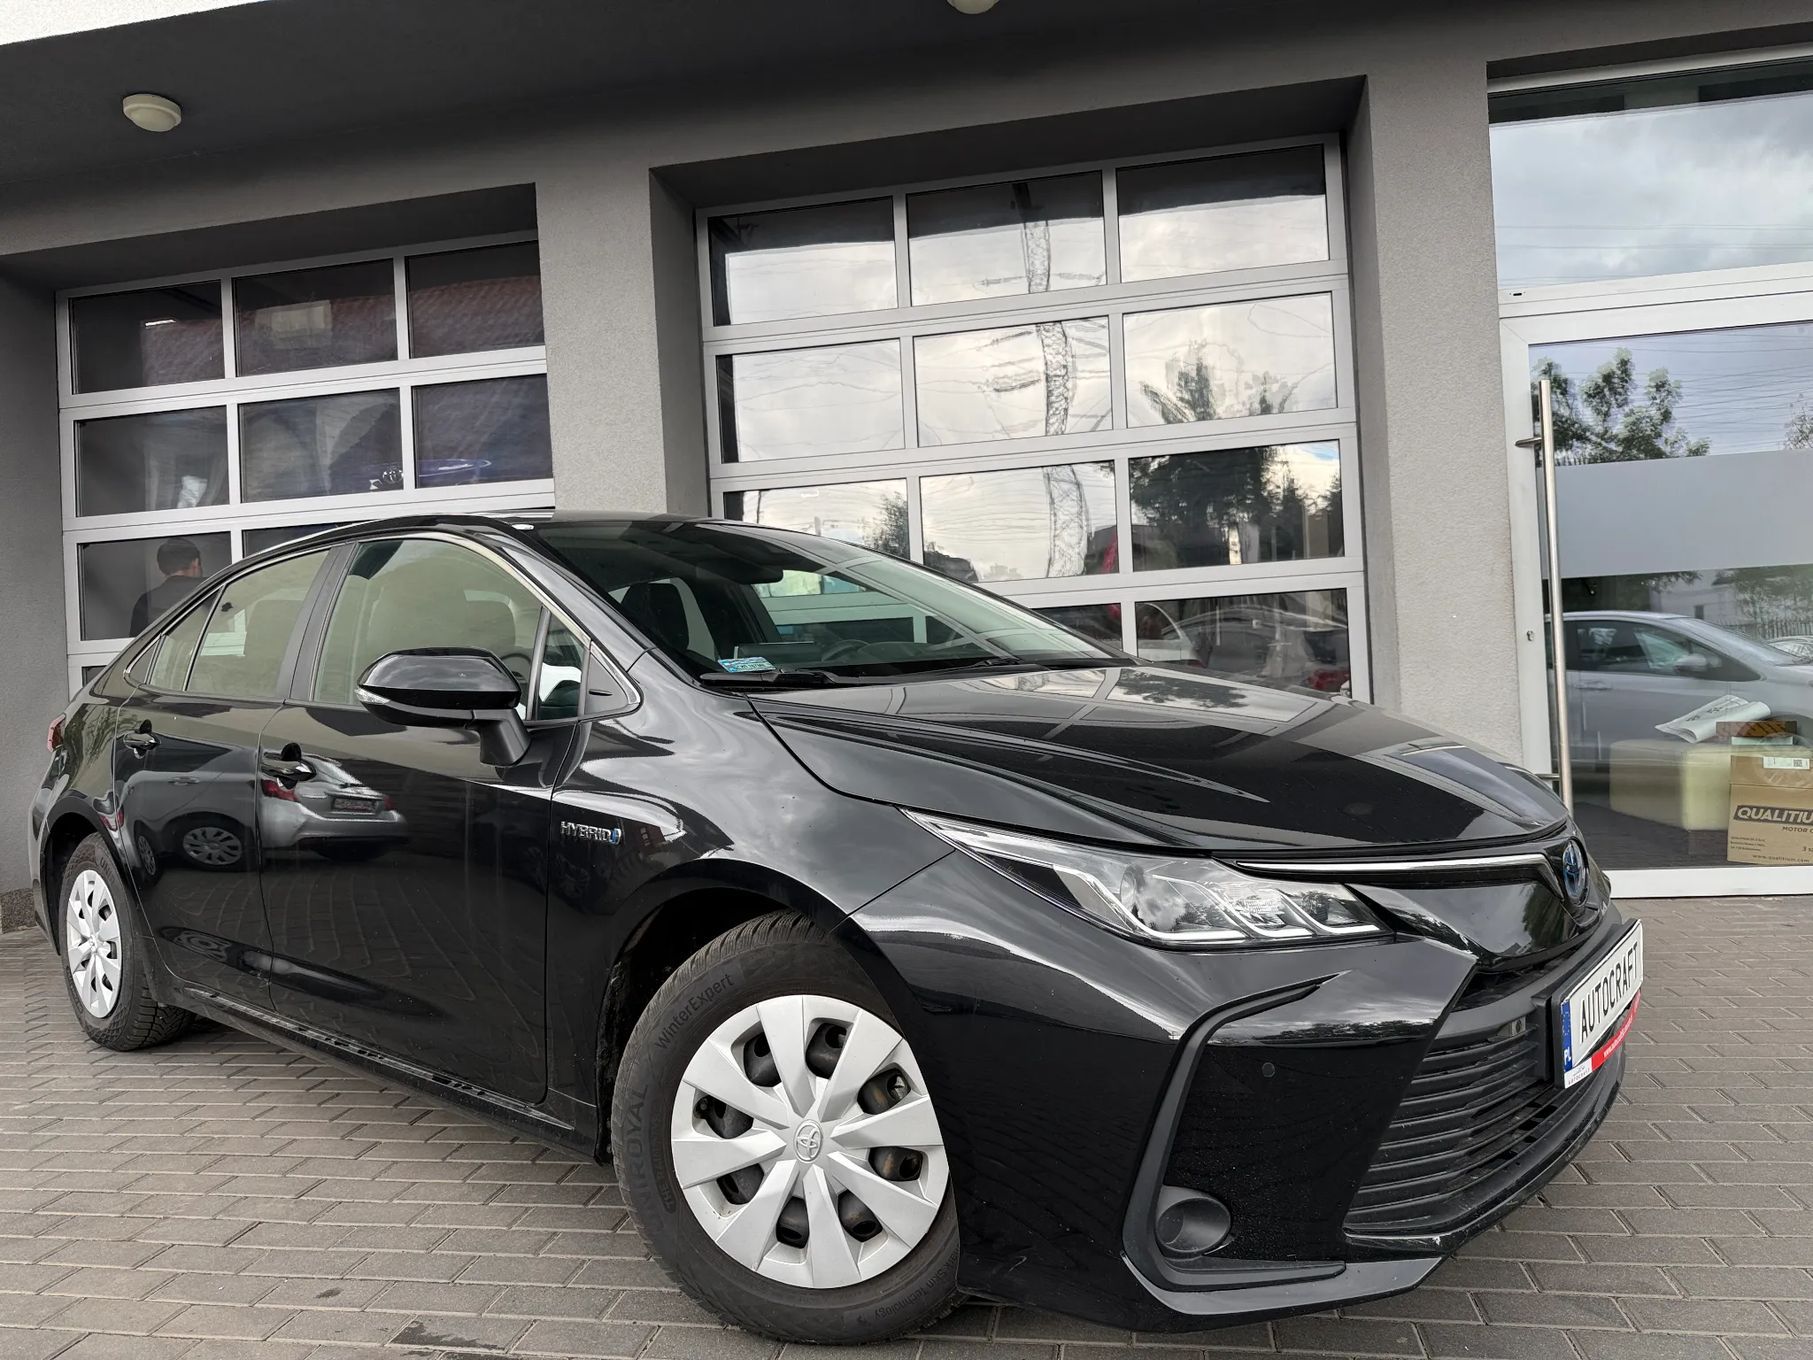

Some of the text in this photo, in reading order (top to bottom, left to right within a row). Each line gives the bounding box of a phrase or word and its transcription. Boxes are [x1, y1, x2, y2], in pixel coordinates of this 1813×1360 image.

[1737, 807, 1813, 824] QUALITIU
[560, 821, 611, 841] HYBRID
[1581, 941, 1639, 1043] AUTOCRAFT
[653, 973, 735, 1049] WinterExpert
[1564, 1048, 1572, 1066] PL
[874, 1287, 929, 1320] Technology
